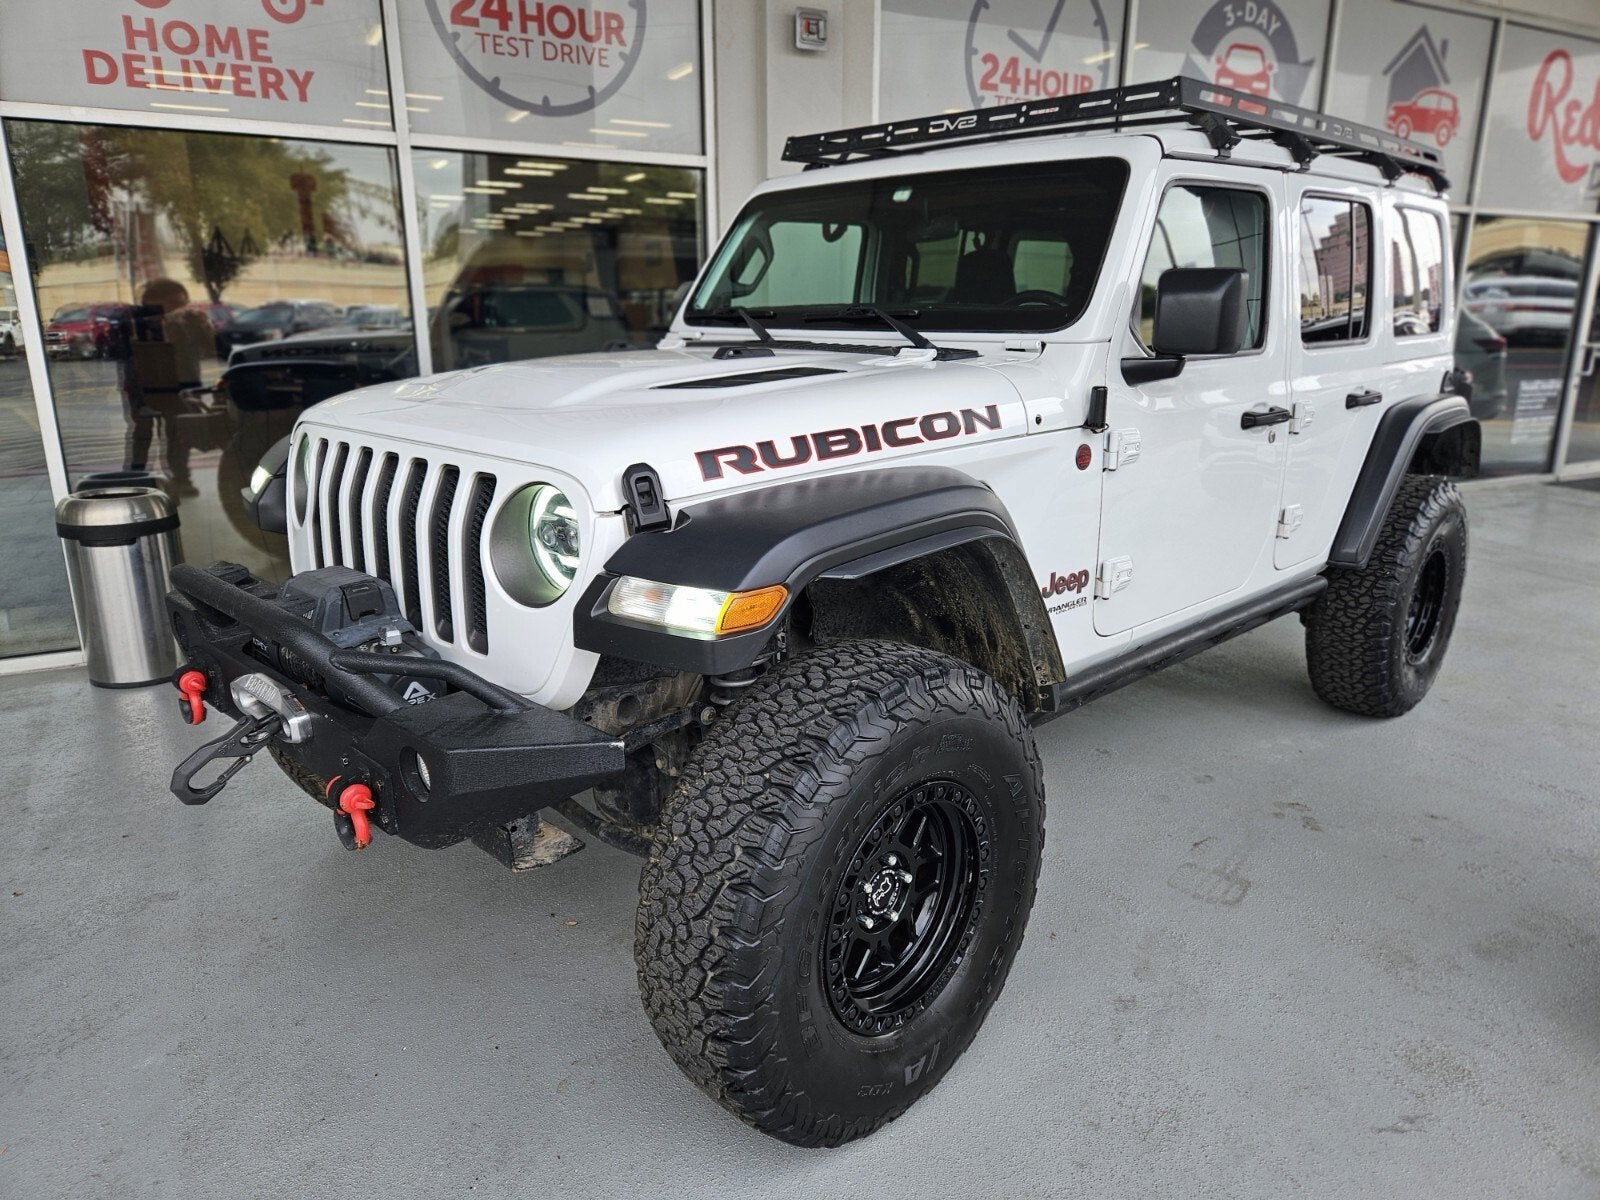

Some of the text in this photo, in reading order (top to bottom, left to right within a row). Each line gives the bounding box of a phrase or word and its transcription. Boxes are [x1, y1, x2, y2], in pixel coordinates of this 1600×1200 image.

[122, 15, 273, 63] HOME
[1223, 1, 1282, 36] 3-DAY
[475, 32, 610, 68] TEST DRIVE
[82, 49, 315, 102] DELIVERY
[694, 404, 1003, 482] RUBICON
[1042, 569, 1090, 599] Jeep
